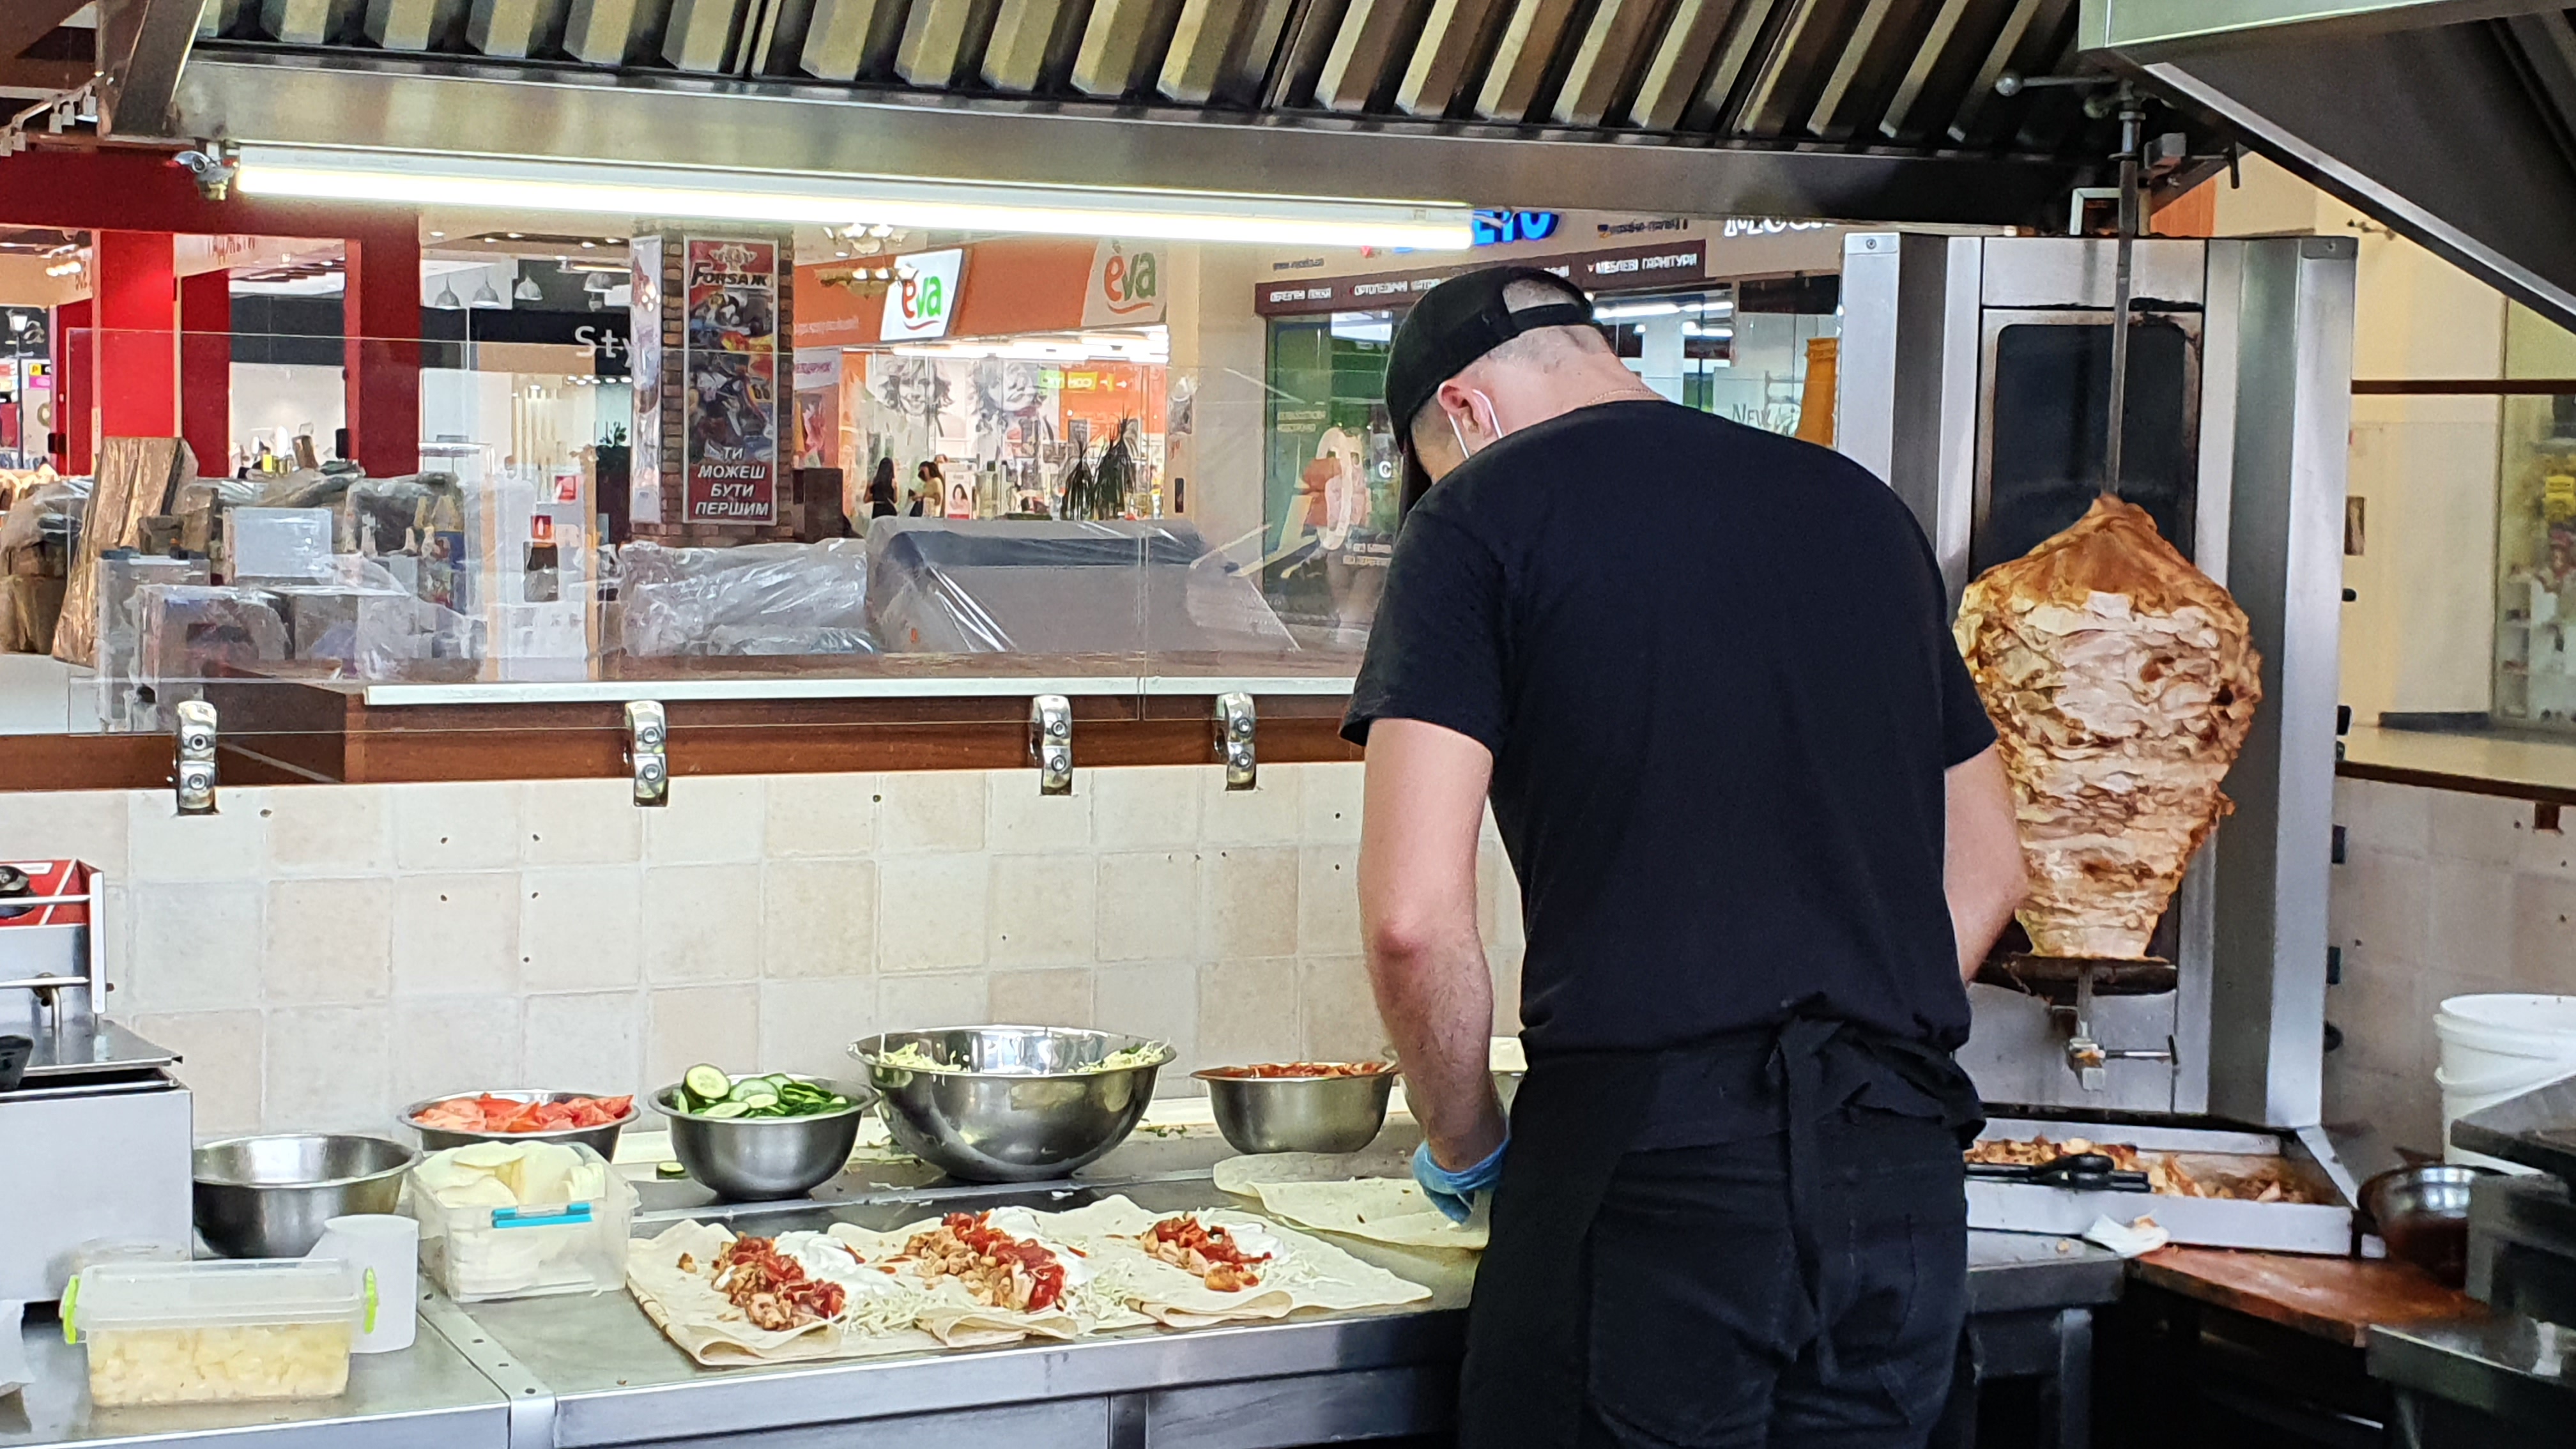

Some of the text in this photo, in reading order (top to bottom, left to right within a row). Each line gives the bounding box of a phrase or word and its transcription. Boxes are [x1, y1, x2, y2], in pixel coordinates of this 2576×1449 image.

[1103, 252, 1156, 302] eva
[901, 275, 941, 319] eva
[723, 447, 744, 460] ТИ
[697, 464, 765, 479] МОЖЕШ
[710, 483, 755, 497] БУТИ
[695, 502, 769, 516] ПЕРШИМ
